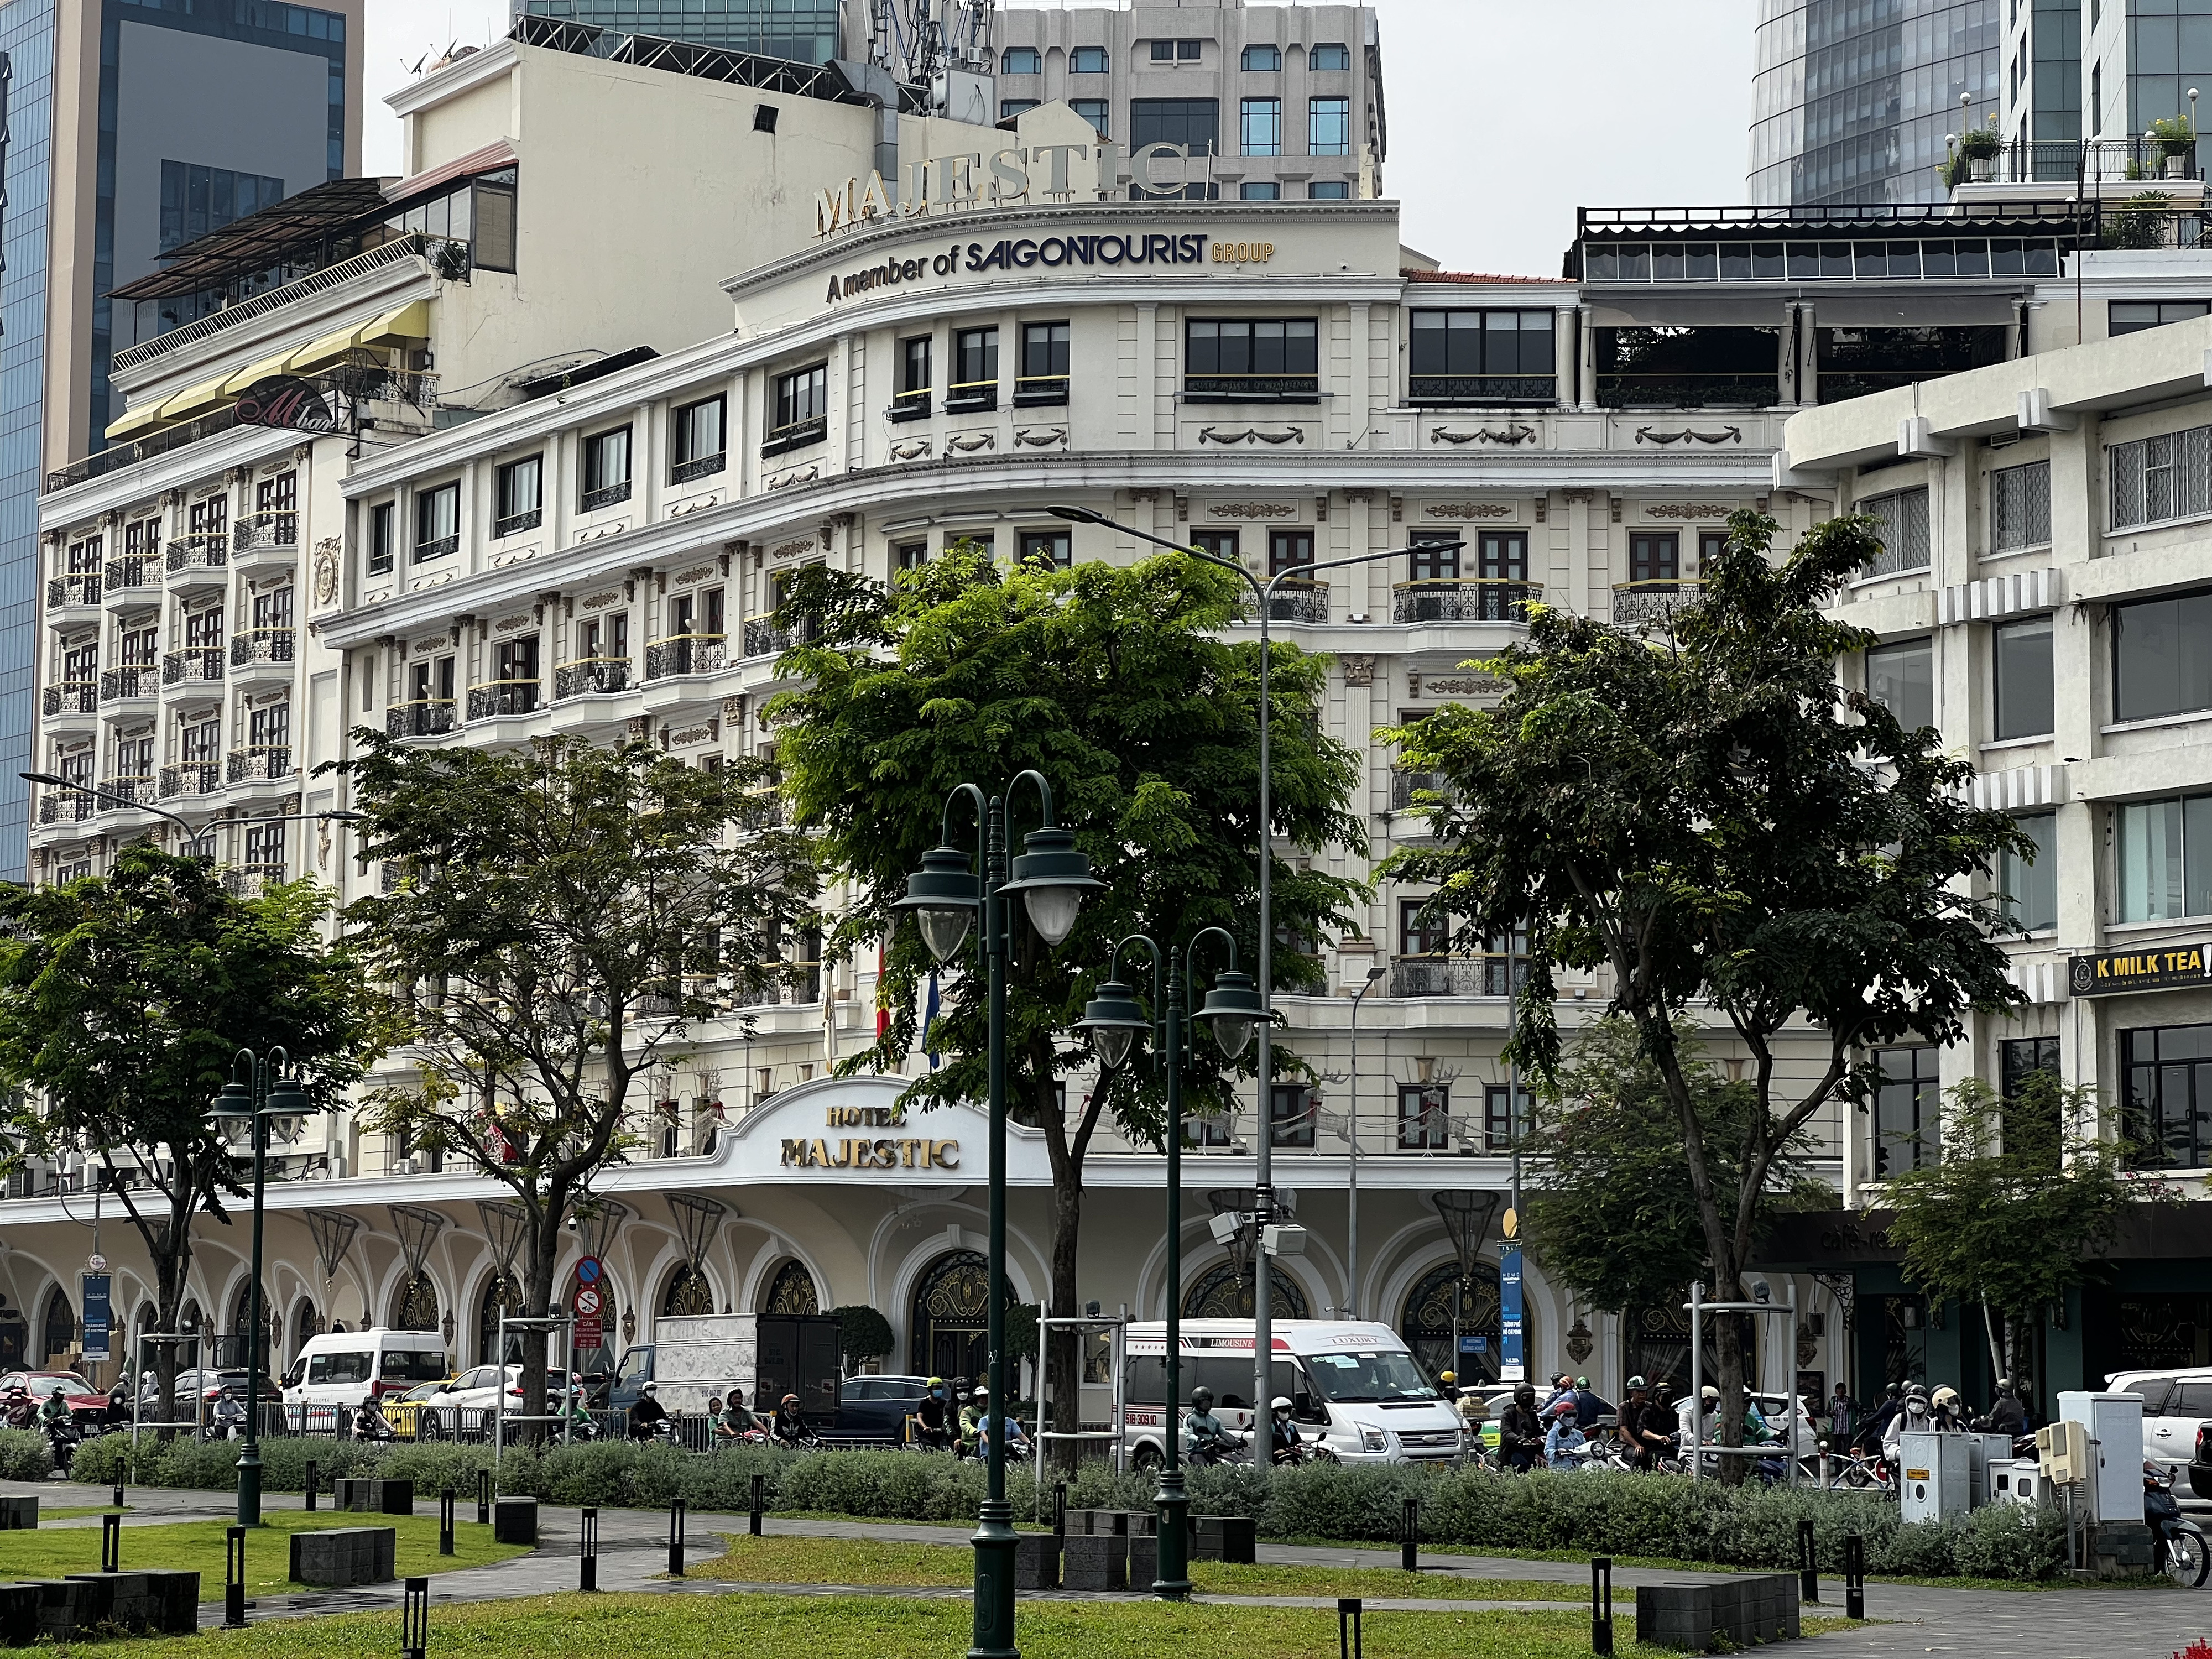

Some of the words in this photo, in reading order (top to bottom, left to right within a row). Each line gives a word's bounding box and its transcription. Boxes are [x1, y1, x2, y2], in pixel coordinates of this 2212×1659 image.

[813, 142, 1188, 232] MAJESTIC
[826, 275, 842, 304] A
[843, 257, 928, 298] member
[933, 244, 961, 276] of
[964, 234, 1208, 271] SAIGONTOURIST
[1211, 242, 1274, 263] GROUP
[2096, 958, 2110, 978] K
[2114, 954, 2160, 977] MILK
[2164, 950, 2202, 972] TEA
[825, 1107, 907, 1127] HOTEL
[780, 1138, 960, 1168] MAJESTIC
[1211, 1339, 1253, 1347] LIMOUSINE
